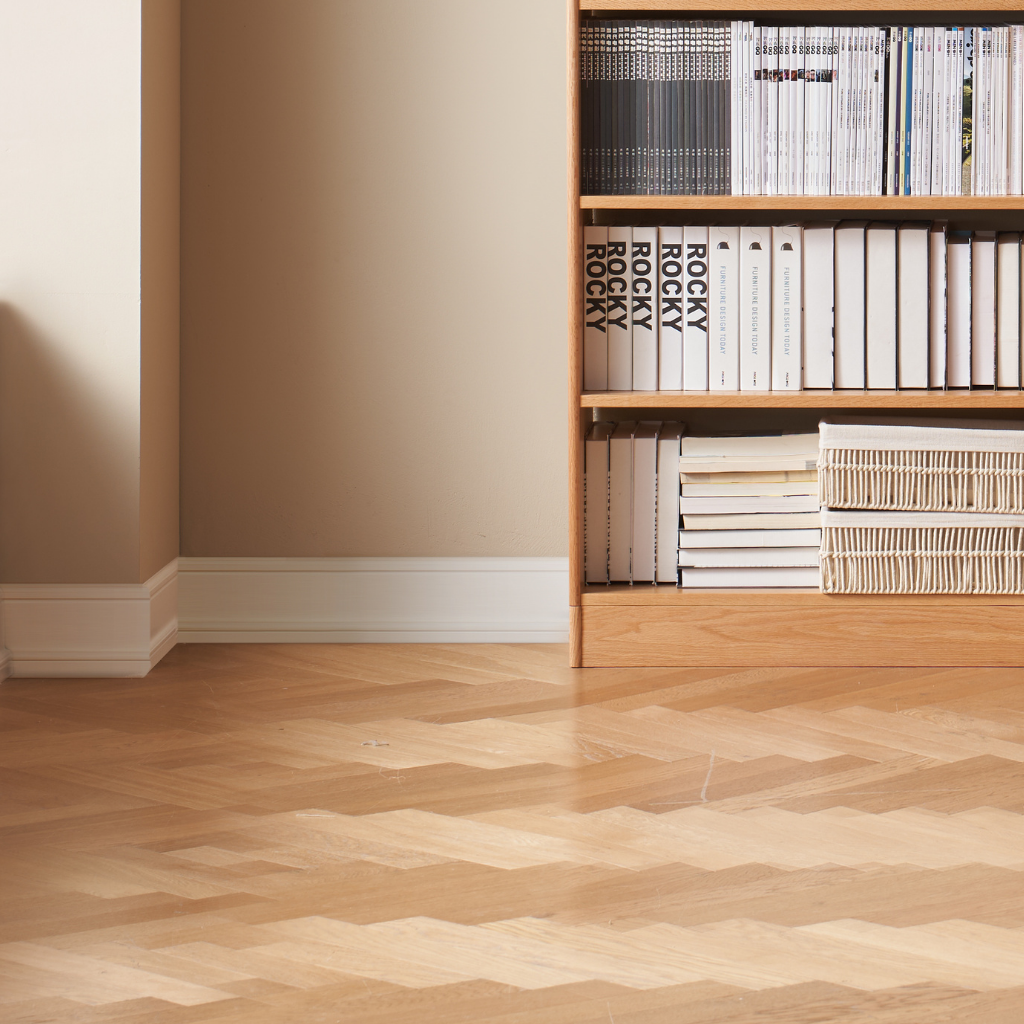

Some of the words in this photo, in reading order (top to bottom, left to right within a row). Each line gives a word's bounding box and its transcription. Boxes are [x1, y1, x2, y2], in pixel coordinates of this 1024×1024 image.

[586, 244, 606, 334] ROCKY
[608, 242, 628, 330] ROCKY
[632, 242, 652, 331] ROCKY
[662, 244, 682, 332] ROCKY
[686, 244, 708, 332] ROCKY
